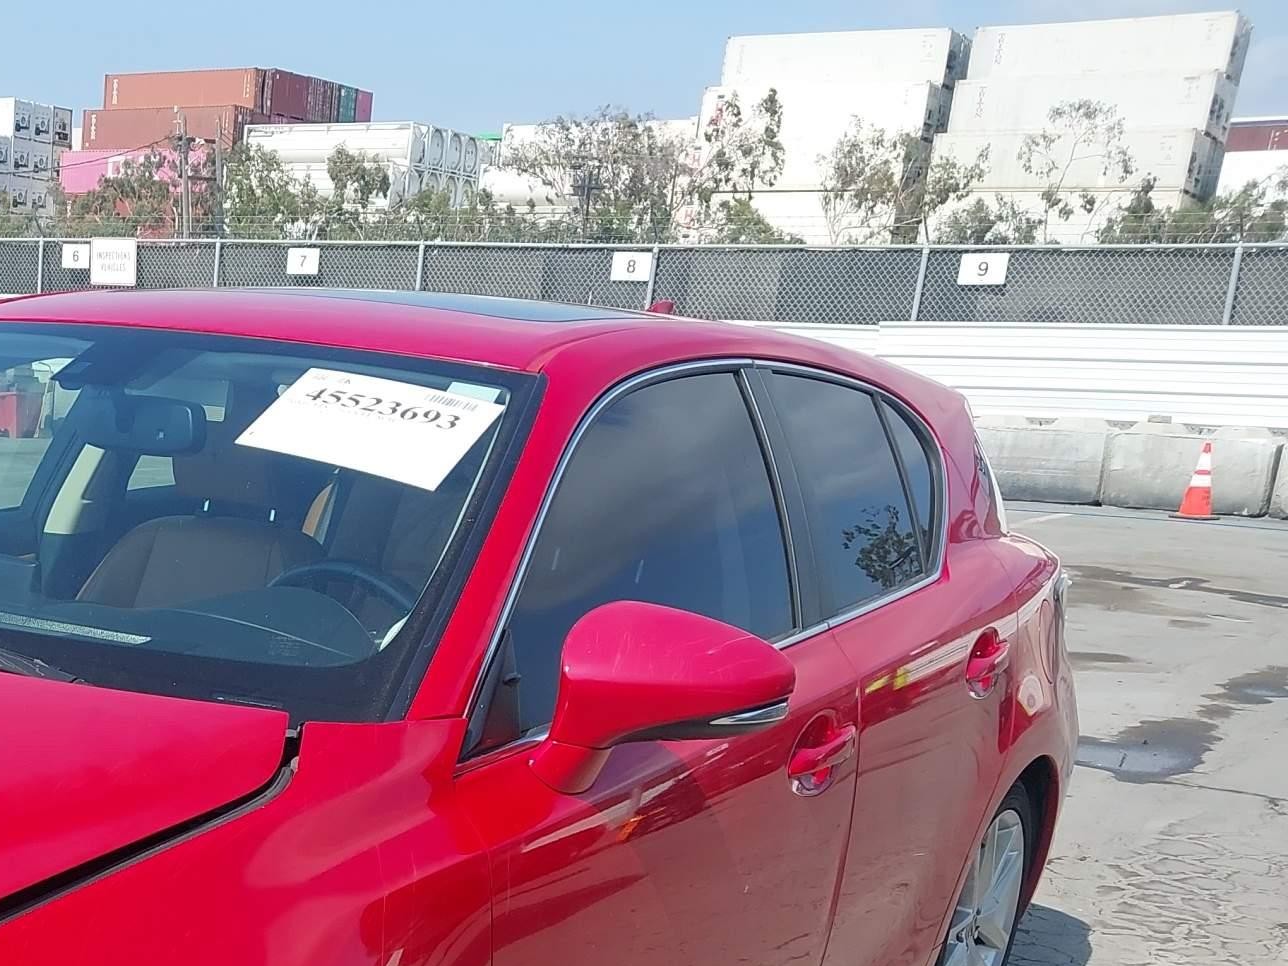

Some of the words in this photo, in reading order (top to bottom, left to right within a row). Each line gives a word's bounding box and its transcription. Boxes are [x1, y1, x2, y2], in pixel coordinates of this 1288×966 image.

[72, 250, 79, 262] 6
[300, 255, 307, 267] 7
[626, 259, 636, 273] 8
[976, 261, 989, 277] 9
[305, 387, 461, 430] 45523693
